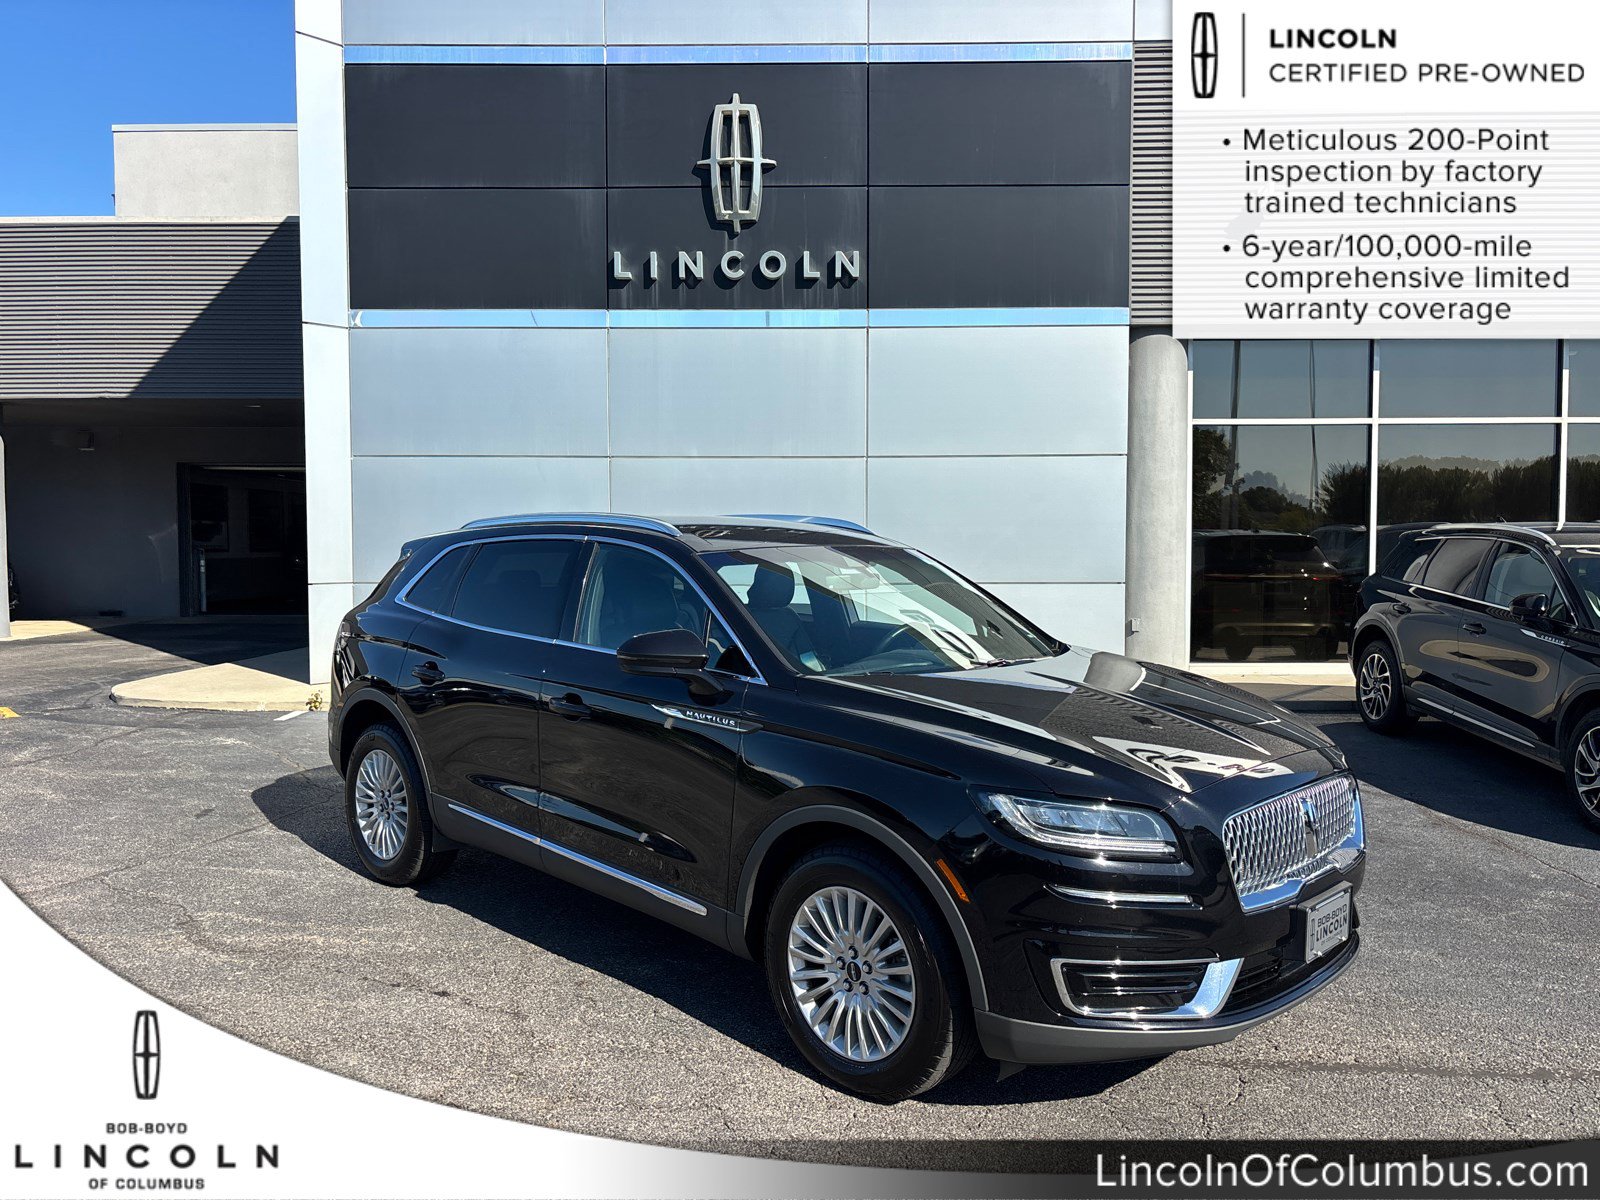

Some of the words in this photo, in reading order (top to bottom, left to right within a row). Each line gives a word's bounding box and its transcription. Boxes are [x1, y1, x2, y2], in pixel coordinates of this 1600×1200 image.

[613, 250, 860, 280] LINCOLN
[685, 710, 736, 727] NAUTILUS
[1316, 912, 1348, 942] LINCOLN
[1317, 903, 1348, 928] BOB-BOYD
